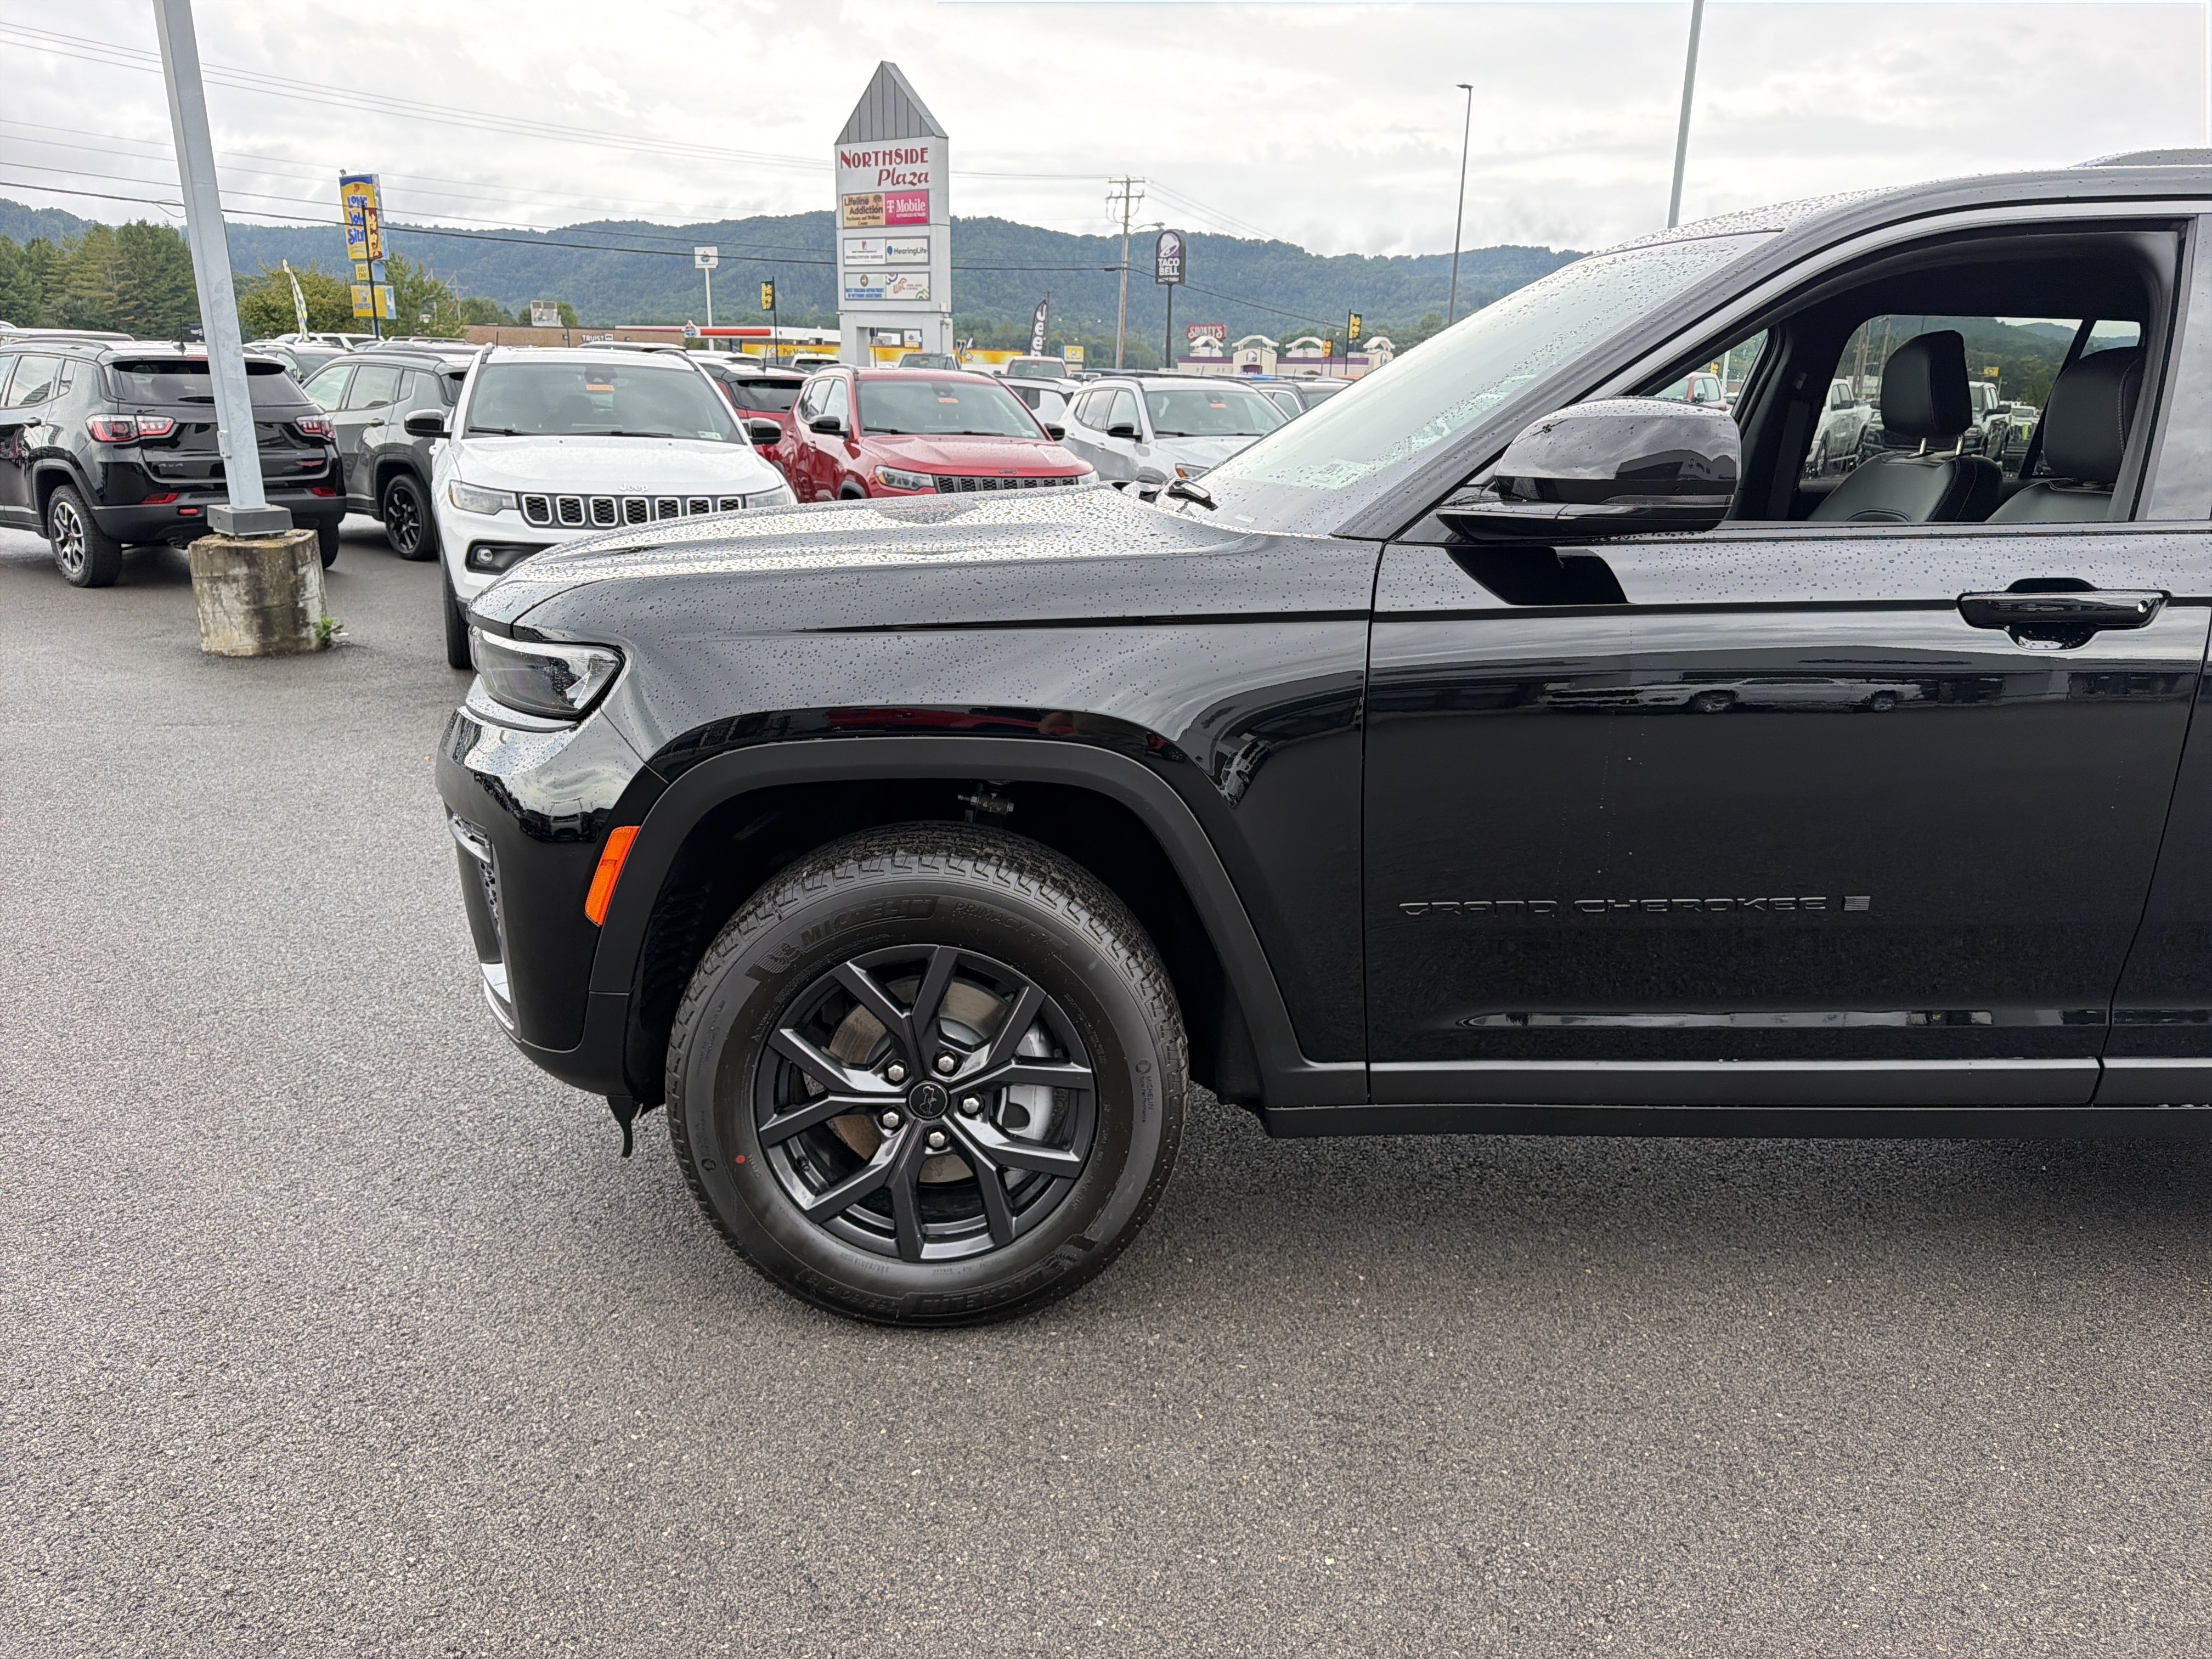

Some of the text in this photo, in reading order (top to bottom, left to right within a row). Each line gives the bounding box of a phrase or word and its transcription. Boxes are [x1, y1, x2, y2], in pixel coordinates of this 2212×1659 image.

[840, 147, 928, 168] NORTHSIDE
[877, 167, 929, 187] Plaza
[844, 196, 869, 206] Lifeline
[896, 198, 926, 213] Mobile
[849, 205, 883, 215] Addiction
[894, 247, 927, 256] HearingLife
[1158, 257, 1180, 267] TACO
[1159, 267, 1180, 276] BELL
[619, 482, 648, 493] Jeep
[1399, 896, 1827, 917] GRAND CHEROKEE
[952, 901, 1029, 932] PRIMACY
[1146, 1075, 1155, 1110] MICHELIN
